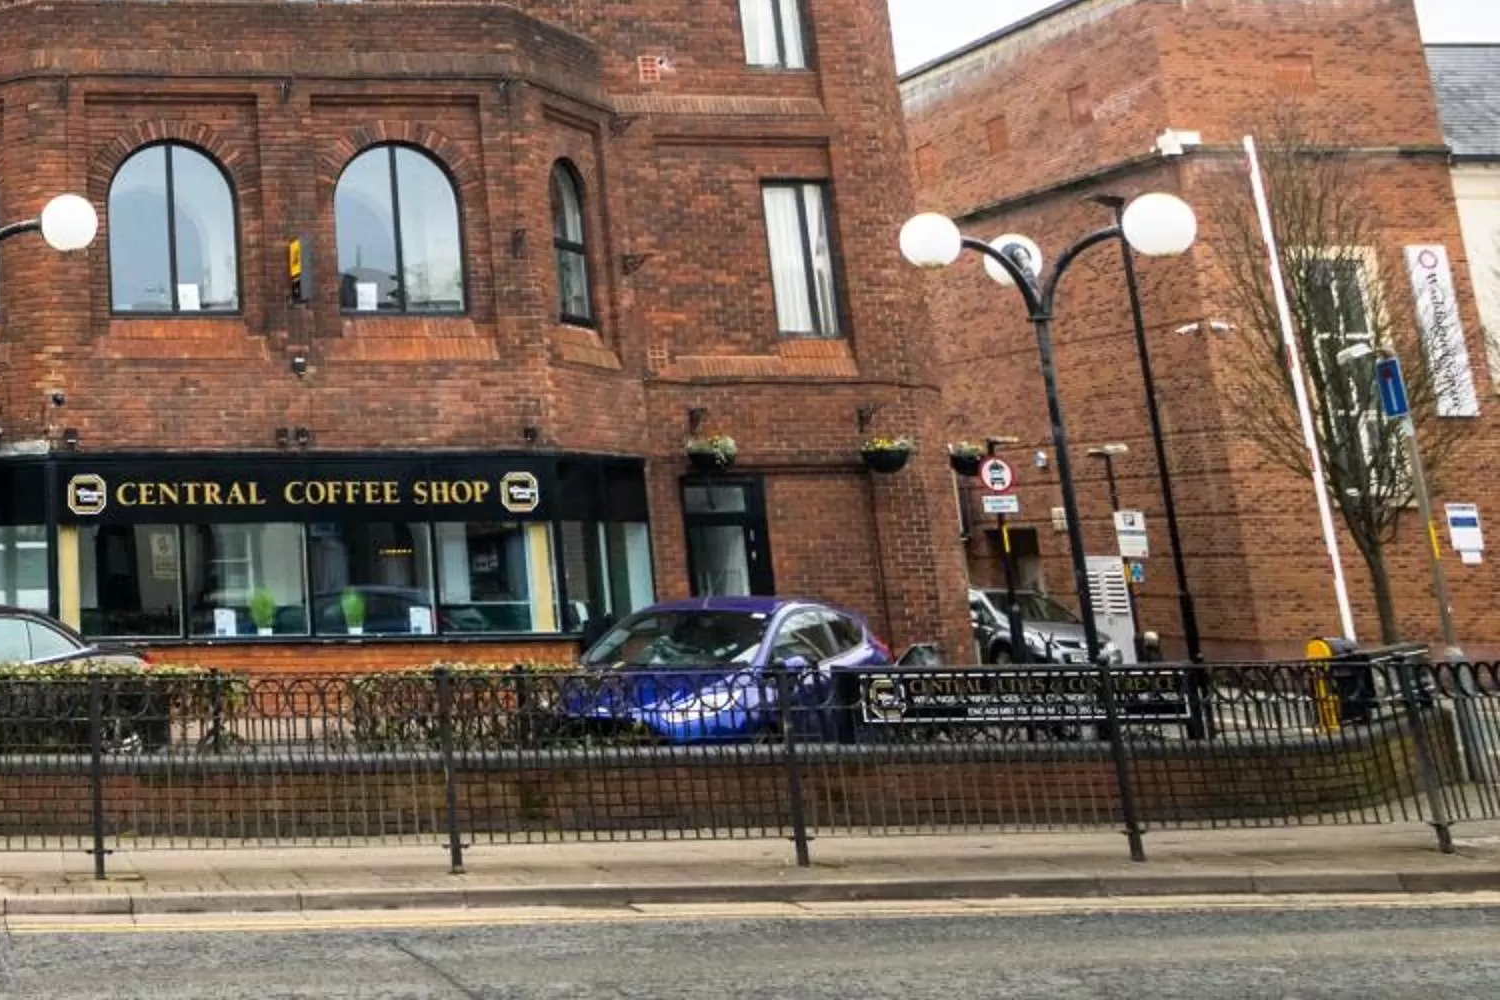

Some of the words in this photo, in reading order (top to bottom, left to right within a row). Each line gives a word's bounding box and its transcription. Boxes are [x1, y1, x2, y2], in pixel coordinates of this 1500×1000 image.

[116, 481, 267, 505] CENTRAL
[284, 480, 401, 505] COFFEE
[413, 480, 491, 505] SHOP
